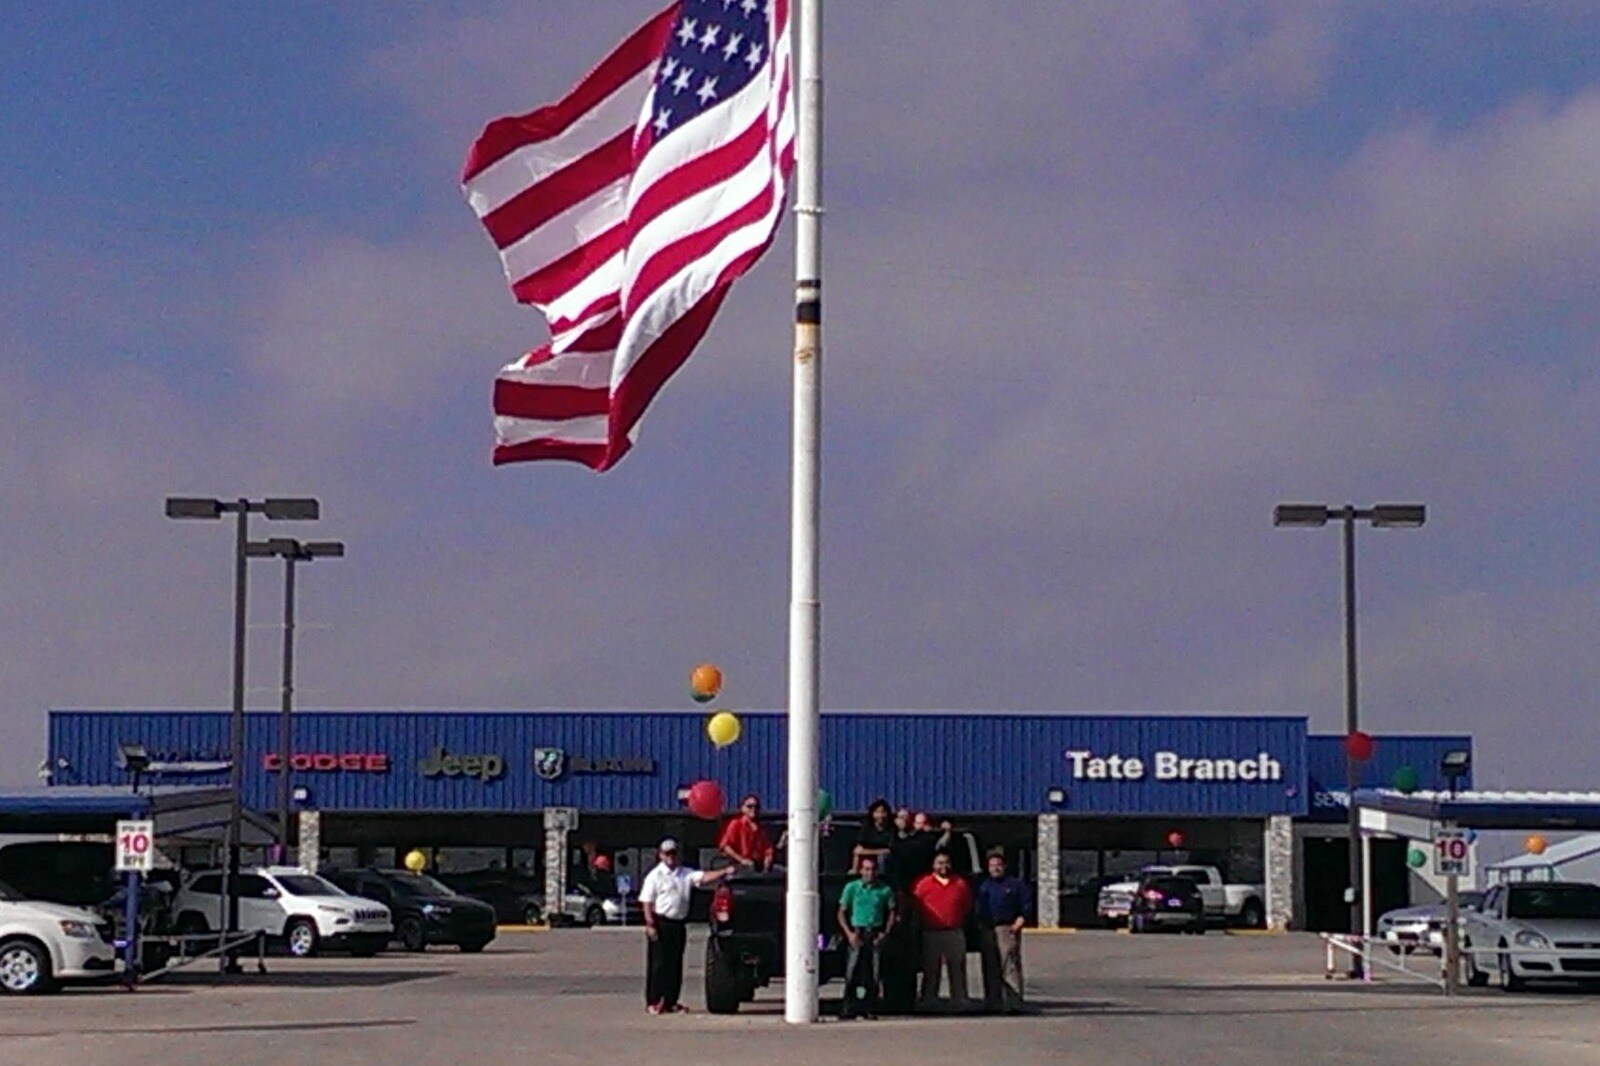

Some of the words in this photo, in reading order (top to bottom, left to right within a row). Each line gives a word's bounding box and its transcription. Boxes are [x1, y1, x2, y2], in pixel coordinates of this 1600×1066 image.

[263, 753, 388, 770] DODGE
[418, 747, 502, 781] Jeep
[1066, 751, 1143, 779] Tate
[1154, 752, 1281, 780] Branch
[122, 834, 150, 854] 10
[1435, 839, 1467, 860] 10
